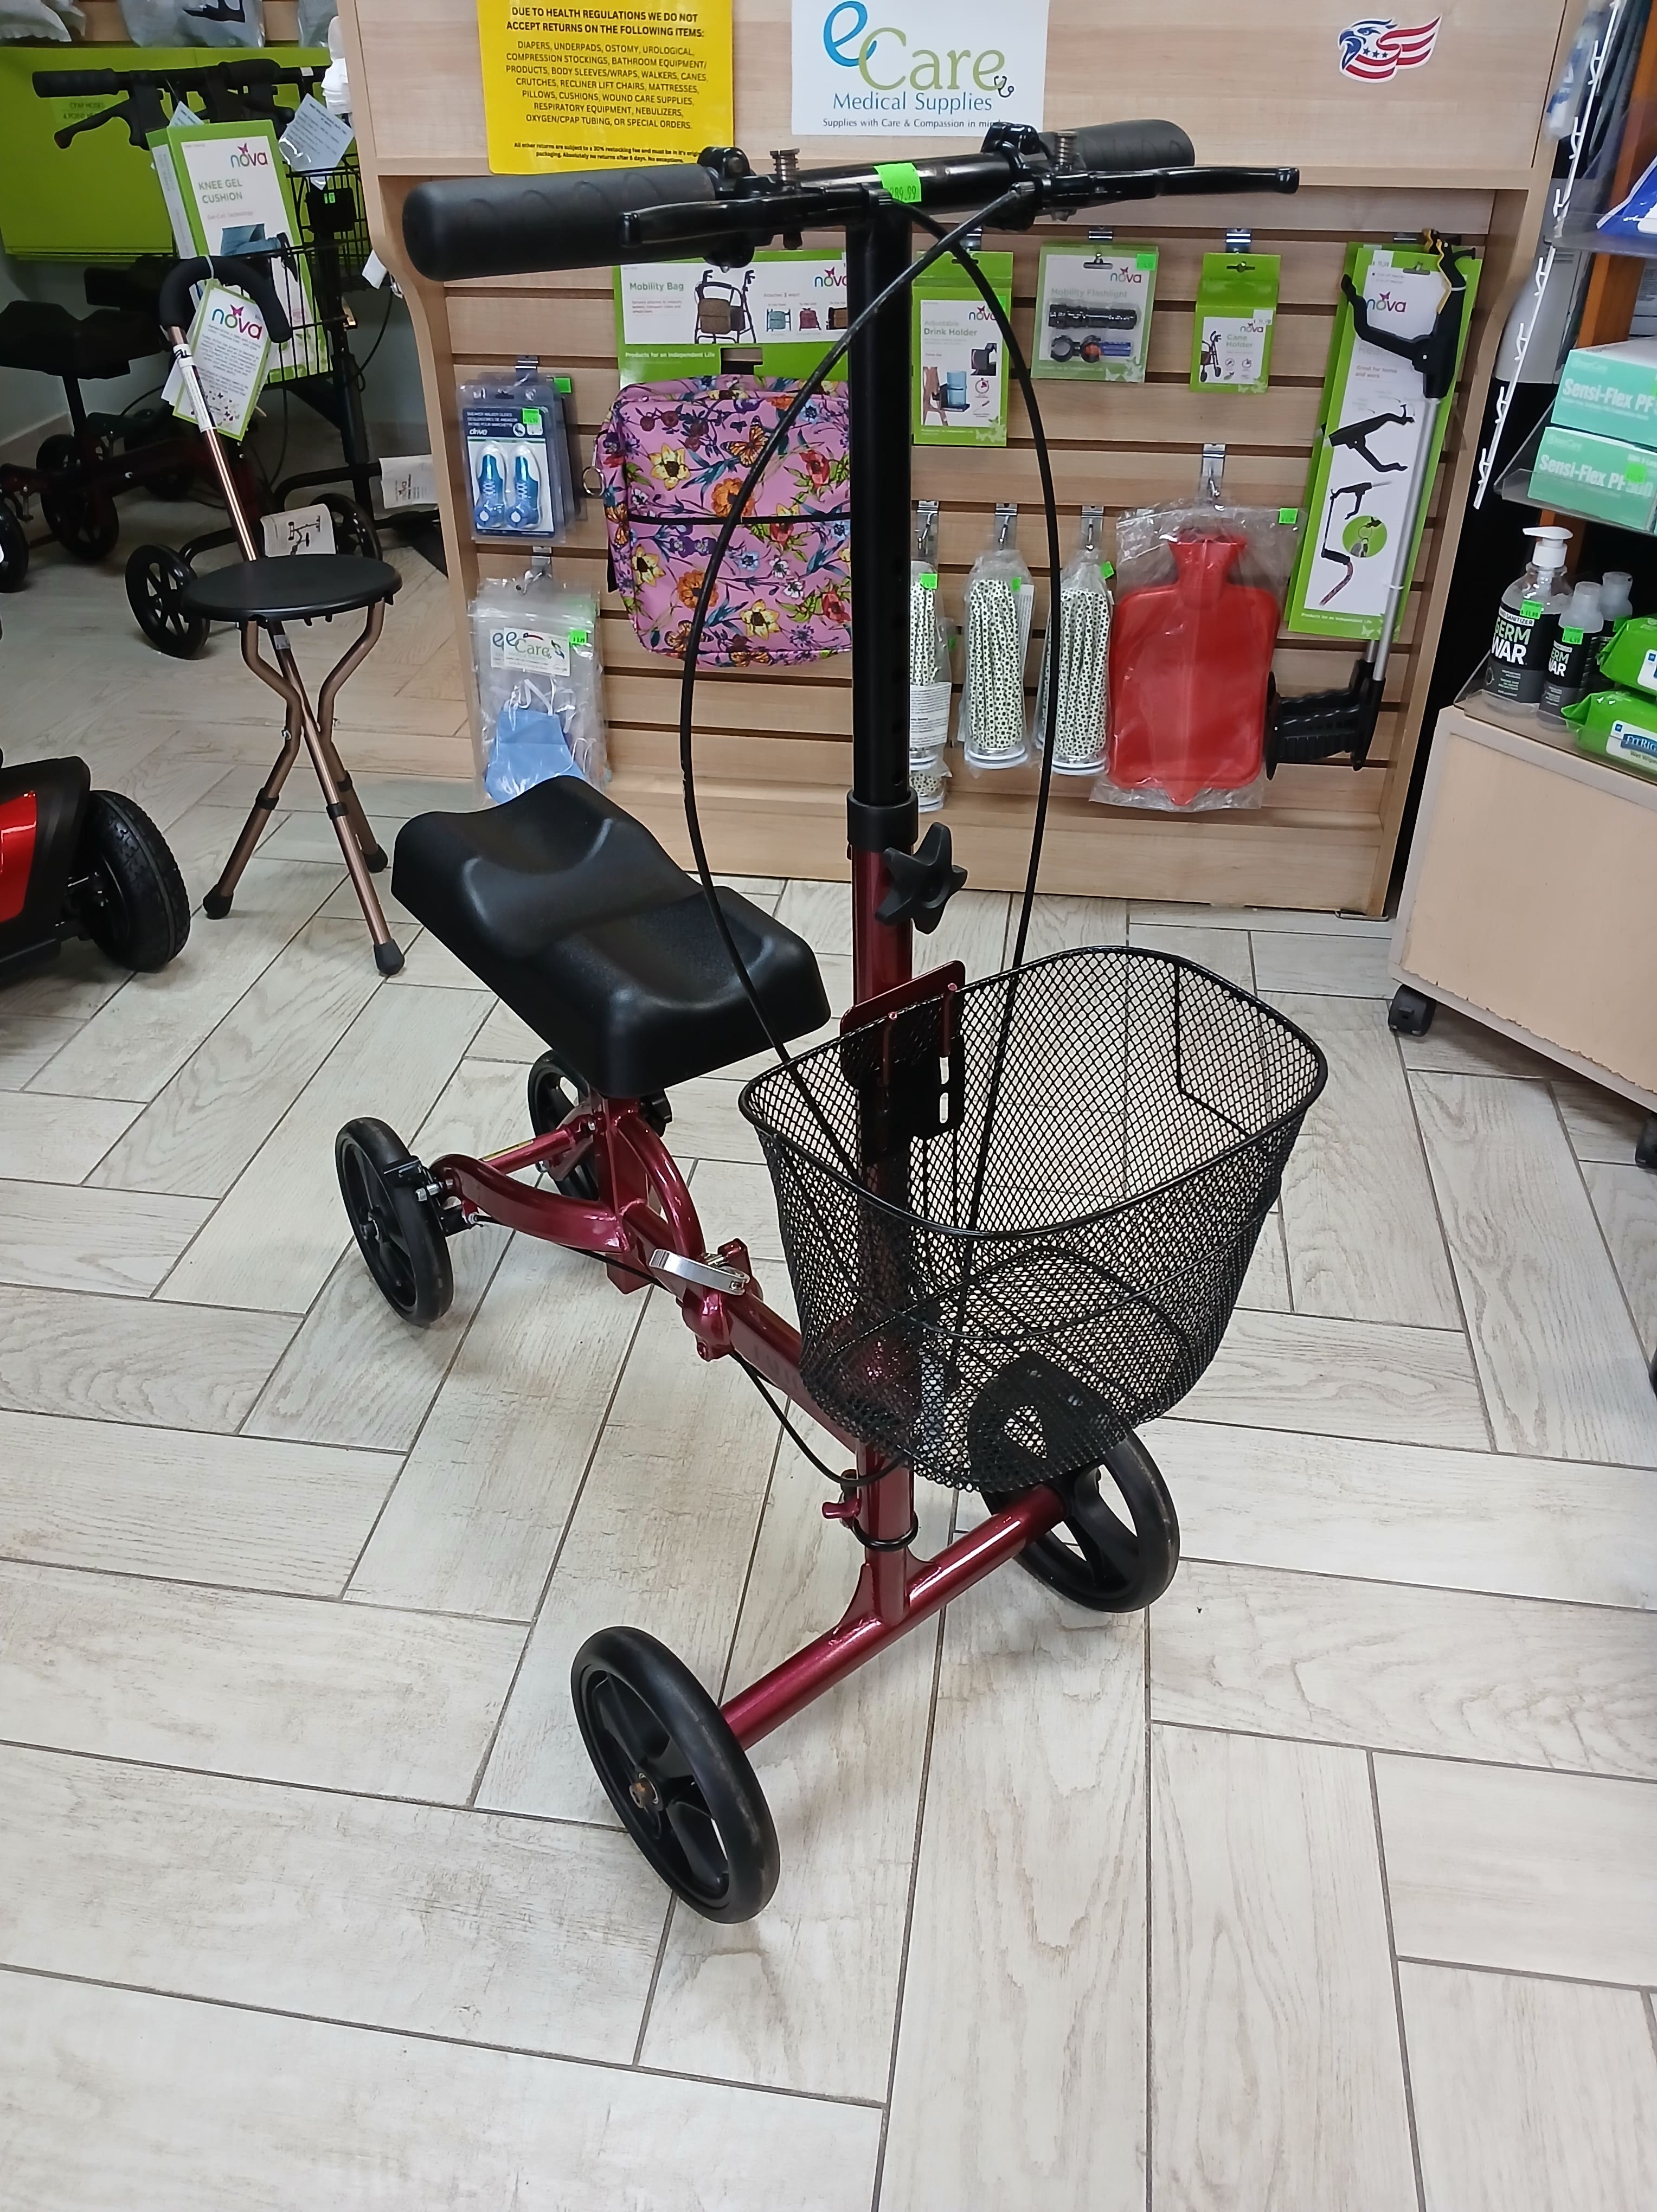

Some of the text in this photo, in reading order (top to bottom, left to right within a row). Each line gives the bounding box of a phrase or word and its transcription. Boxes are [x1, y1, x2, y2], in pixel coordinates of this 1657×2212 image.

[512, 7, 698, 22] DUE TO HEALTH REGULATIONS WE DO NOT
[506, 21, 705, 37] ACCEPT RETURNS ON THE FOLLOWING ITEMS:
[518, 41, 695, 56] DIAPERS, UNDERPADS, OSTOMY, UROLOGICAL,
[823, 1, 1005, 91] eCare
[506, 53, 708, 69] COMPRESSION STOCKINGS, BATHROOM EQUIPMENT/
[506, 65, 708, 82] PRODUCTS, BODY SLEEVES/WRAPS, WALKERS, CANES,
[516, 78, 699, 94] CRUTCHES, RECLINER LIFT CHAIRS, MATTRESSES,
[522, 90, 557, 100] PILLOWS,
[559, 92, 601, 102] CUSHIONS,
[602, 94, 633, 102] WOUND
[657, 96, 695, 106] SUPPLIES,
[833, 91, 993, 115] Medical Supplies
[534, 102, 684, 118] RESPIRATORY EQUIPMENT, NEBULIZERS,
[526, 114, 580, 124] OXYGEN/CPAP
[581, 116, 612, 126] TUBING,
[627, 118, 658, 127] SPECIAL
[660, 120, 692, 129] ORDERS.
[823, 118, 858, 128] Supplies
[860, 119, 878, 127] with
[881, 119, 901, 127] Care
[904, 119, 910, 127] &
[914, 119, 964, 130] Compassion
[968, 119, 975, 127] in
[230, 152, 268, 168] nova
[198, 178, 243, 190] KNEE GEL
[202, 192, 243, 204] CUSHION
[1110, 273, 1142, 283] nova
[630, 282, 684, 292] Mobility Bag
[1051, 288, 1128, 298] Mobility Flashlight
[1366, 299, 1406, 313] nova
[211, 308, 262, 340] nova
[1563, 378, 1633, 409] Sensi-Flex
[1539, 454, 1607, 487] Sensi-Flex
[1495, 616, 1531, 645] GERM
[1492, 633, 1526, 665] WAR
